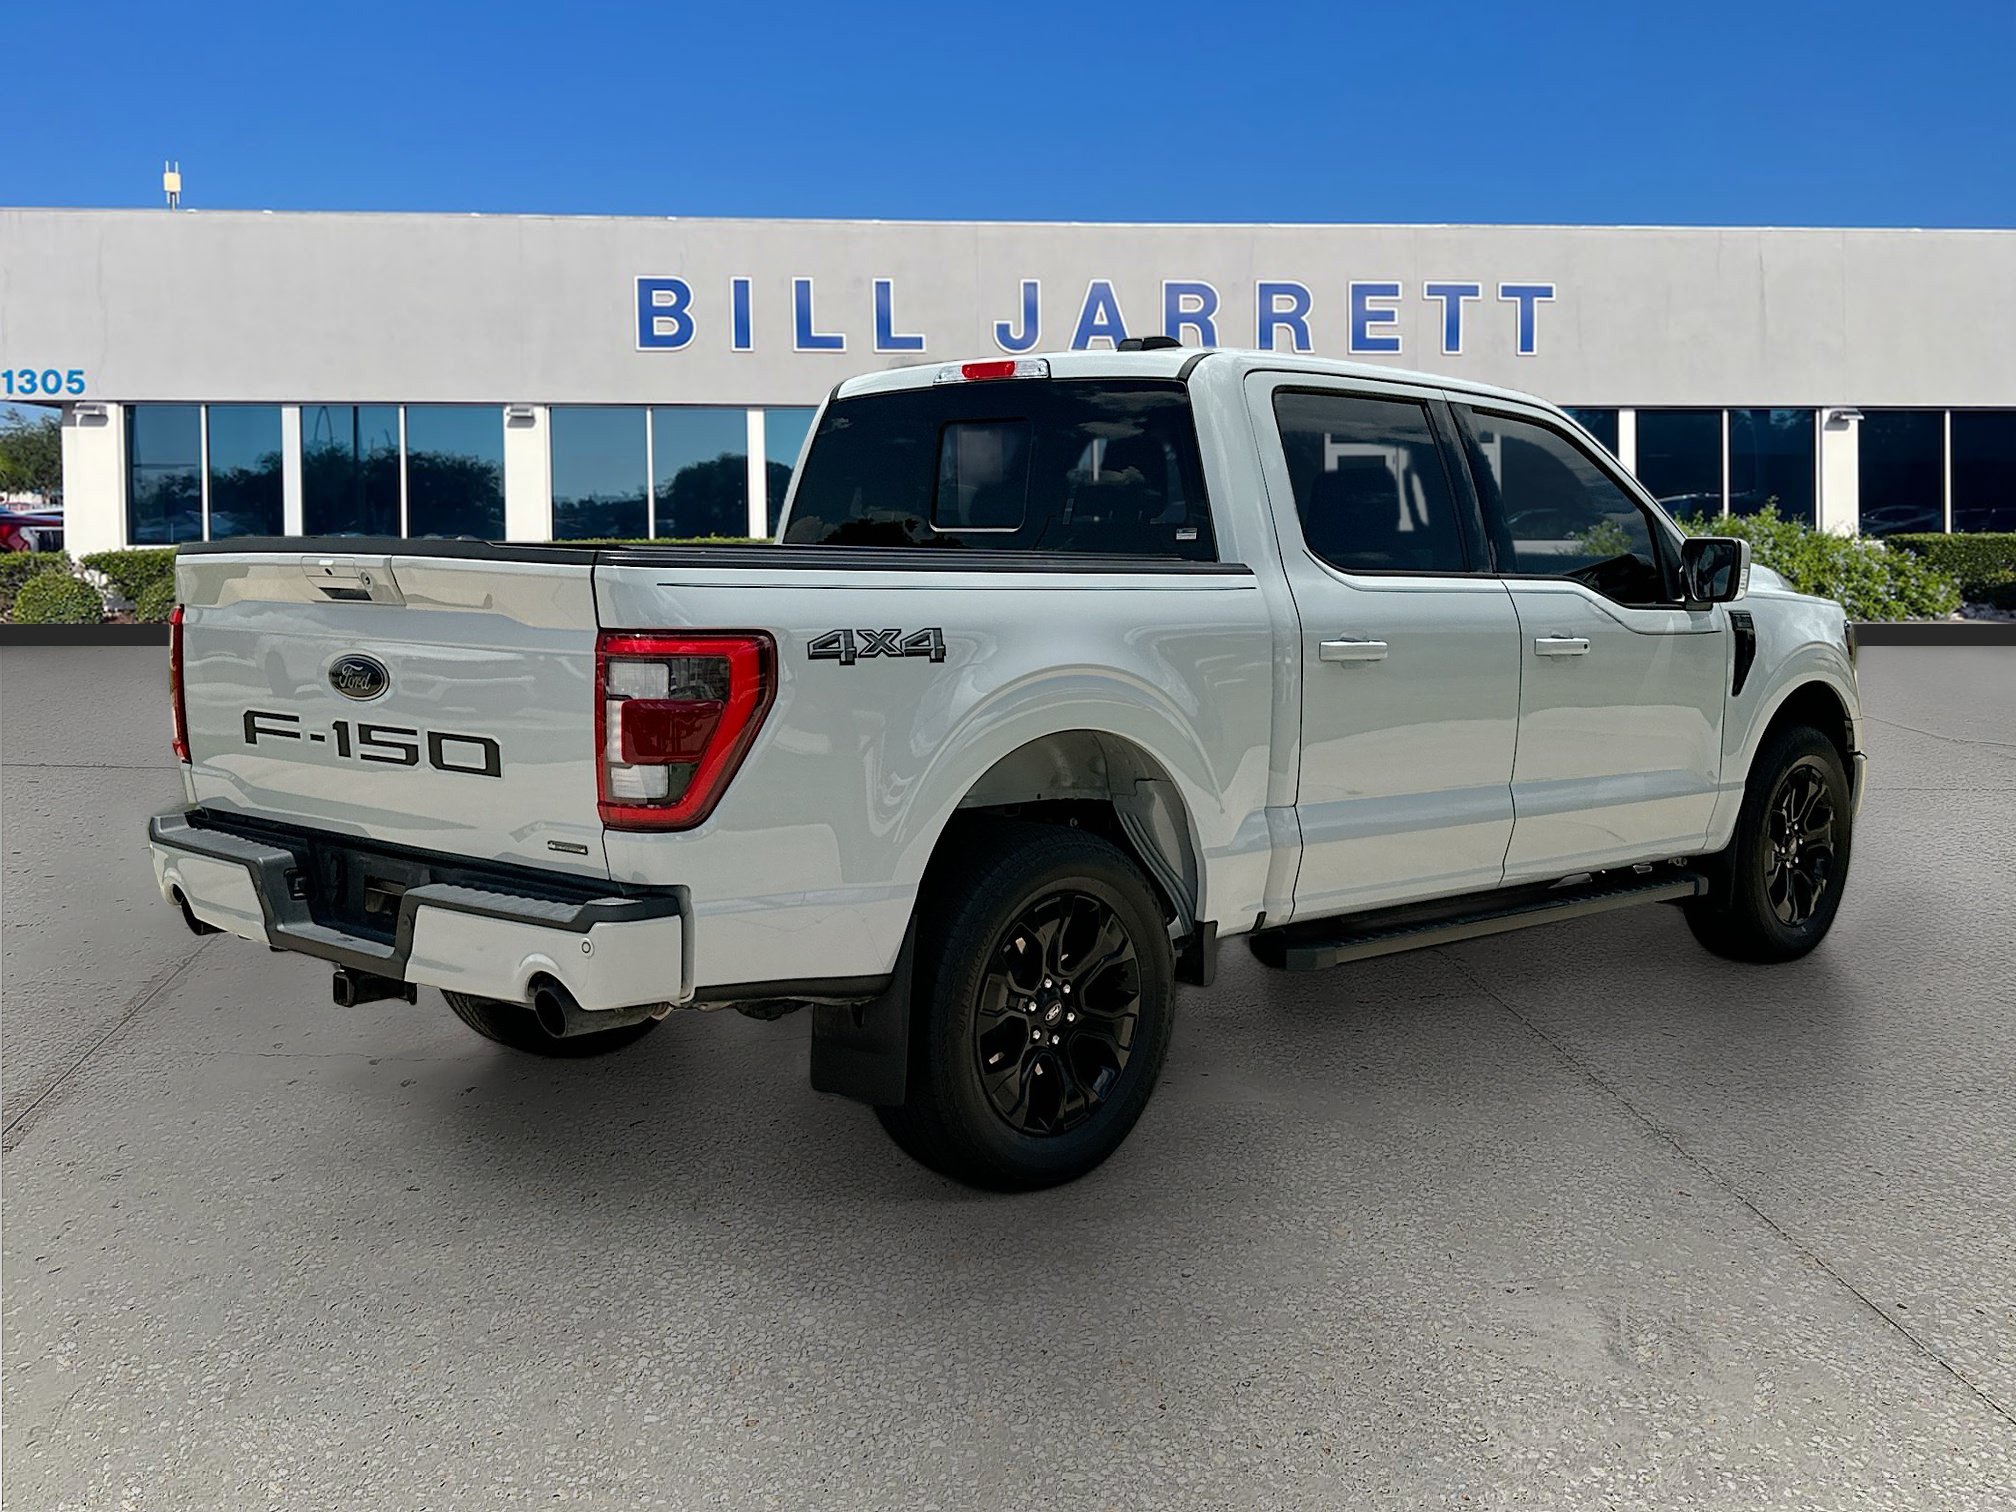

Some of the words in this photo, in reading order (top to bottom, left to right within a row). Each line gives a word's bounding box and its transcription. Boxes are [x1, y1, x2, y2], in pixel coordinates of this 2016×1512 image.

[634, 276, 927, 353] BILL
[993, 279, 1556, 355] JARRETT
[1, 368, 86, 395] 1305
[338, 663, 372, 691] Ford
[243, 709, 502, 778] F-150
